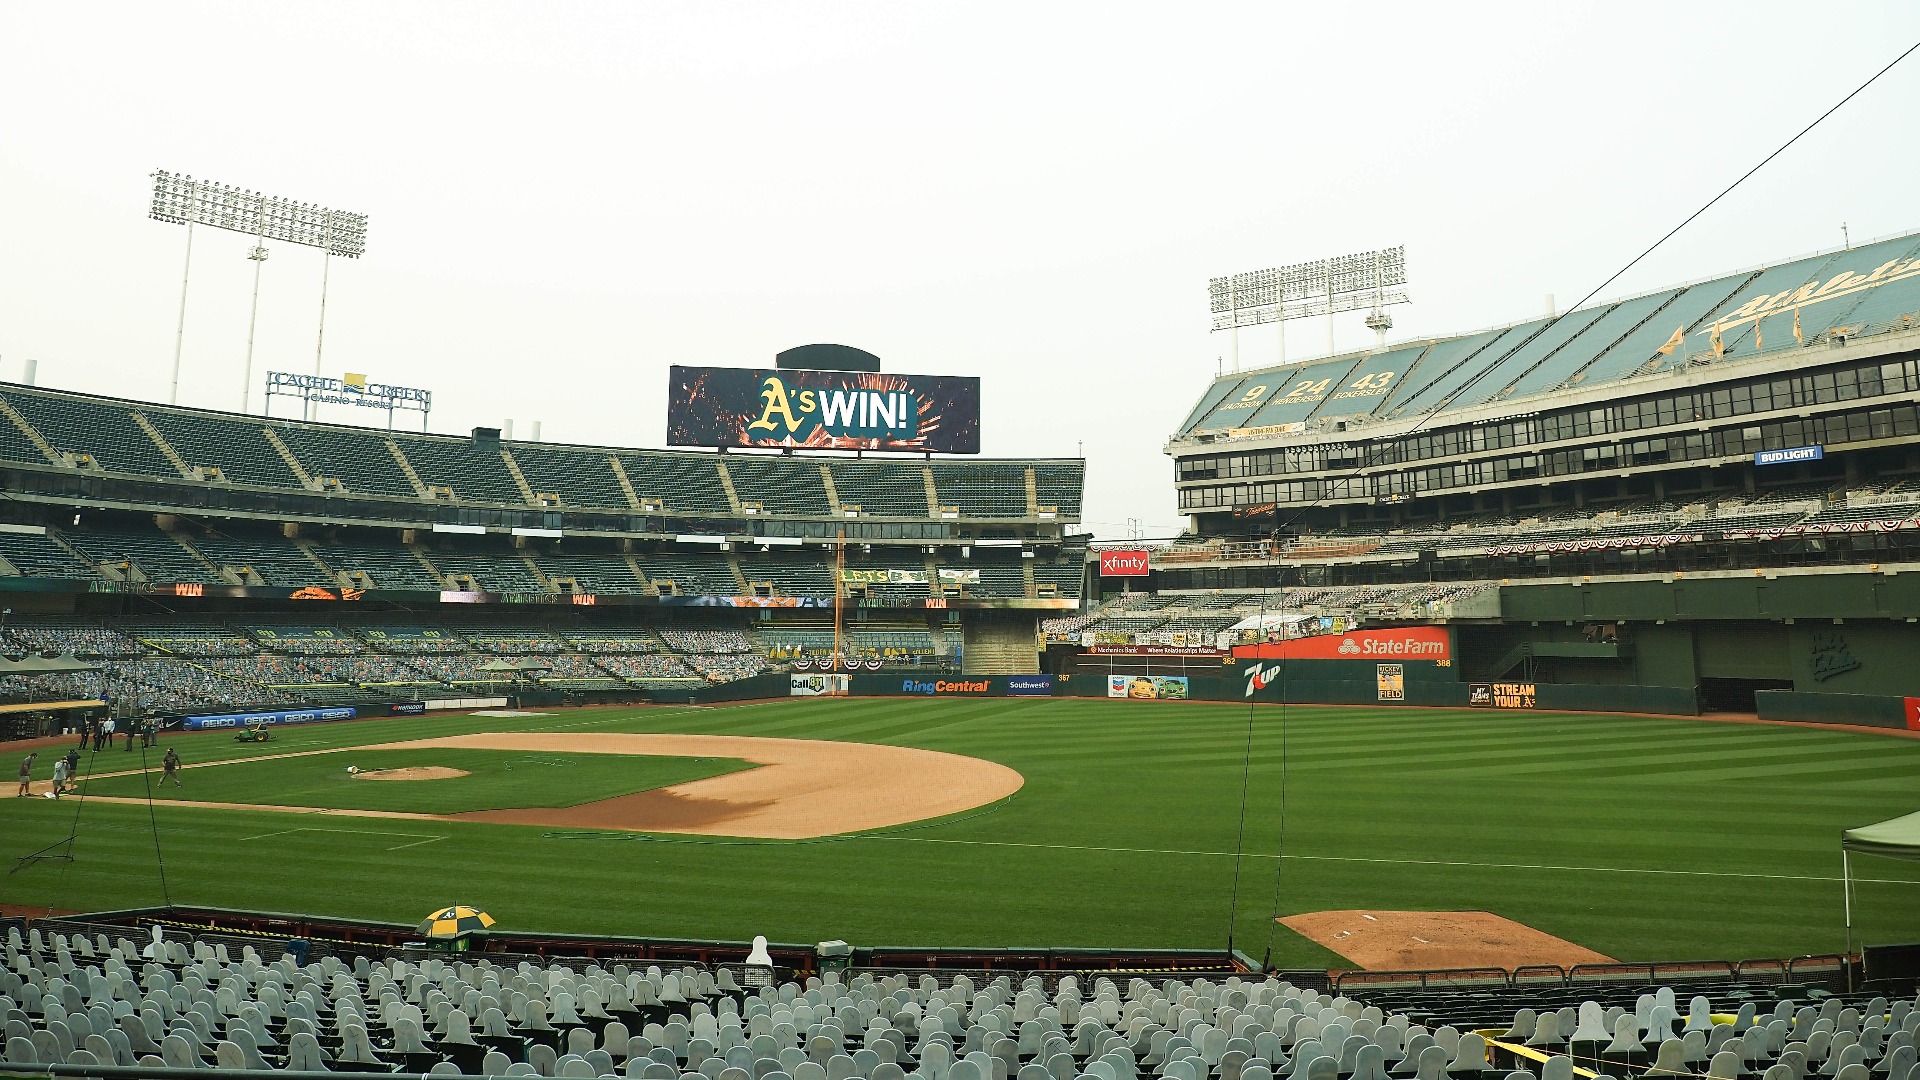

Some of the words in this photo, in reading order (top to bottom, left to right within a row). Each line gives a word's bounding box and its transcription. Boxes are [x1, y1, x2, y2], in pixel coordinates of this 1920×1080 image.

[1350, 371, 1394, 389] 43
[275, 372, 338, 391] CACHE
[368, 383, 424, 401] CREEK
[1286, 378, 1332, 398] 24
[1241, 385, 1266, 402] 9
[1333, 387, 1391, 400] ECKERSLEY
[311, 394, 349, 405] CASINO
[748, 376, 816, 433] A's
[819, 389, 908, 430] WIN!
[1271, 394, 1325, 406] HENDERSON
[1220, 400, 1263, 411] JACKSON
[1761, 451, 1783, 463] BUD
[1784, 448, 1815, 461] LIGHT
[1104, 555, 1146, 572] xfinity
[89, 580, 157, 594] ATHLETICS
[175, 583, 203, 597] WIN
[501, 593, 558, 604] ATHLETICS
[572, 594, 595, 605] WIN
[859, 598, 912, 608] ATHLETICS
[925, 598, 947, 609] WIN
[1125, 646, 1138, 654] Bank
[1164, 647, 1198, 655] Relationships
[1222, 657, 1236, 665] 362
[1436, 659, 1451, 668] 388
[791, 679, 809, 689] Call
[809, 676, 824, 688] 811
[1058, 674, 1070, 682] 367
[902, 678, 989, 695] RingCentral
[1009, 681, 1045, 689] Southwest
[1493, 683, 1536, 696] STREAM
[1380, 690, 1402, 698] FIELD
[1494, 696, 1521, 708] YOUR
[244, 715, 276, 726] GEICO
[284, 713, 315, 724] GEICO
[322, 710, 350, 720] GEICO
[201, 718, 236, 729] GEICO
